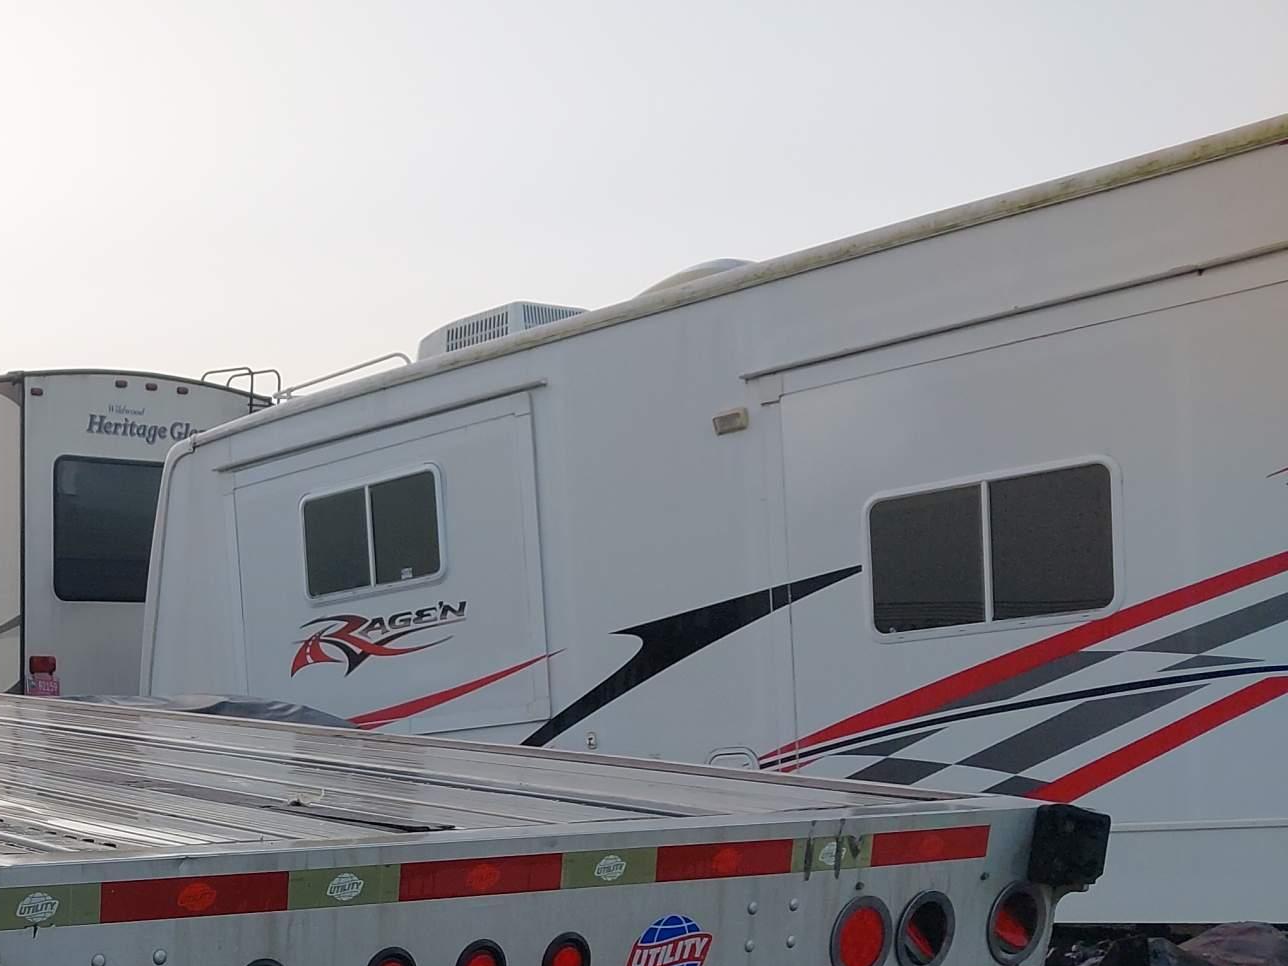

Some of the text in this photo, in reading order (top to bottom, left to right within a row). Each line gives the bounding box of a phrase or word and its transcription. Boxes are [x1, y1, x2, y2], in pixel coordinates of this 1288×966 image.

[86, 414, 168, 445] Heritage
[329, 881, 362, 895] UTILITY
[18, 901, 57, 915] UTILITY
